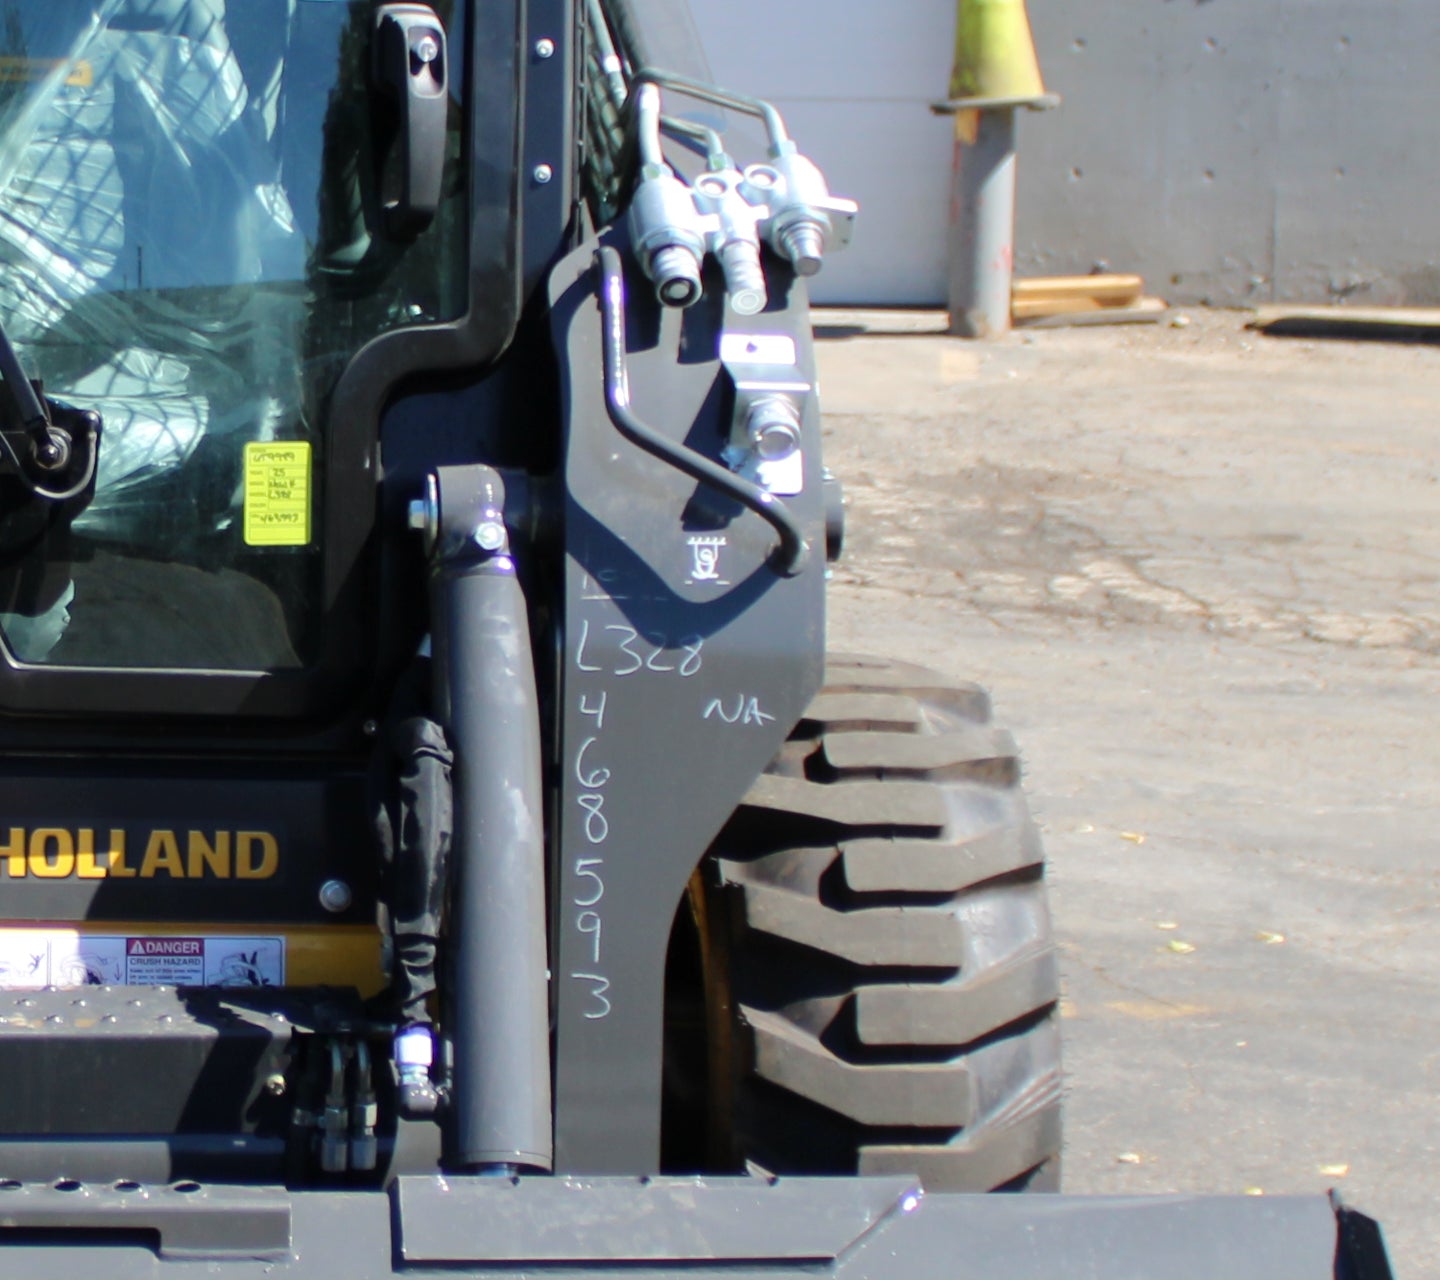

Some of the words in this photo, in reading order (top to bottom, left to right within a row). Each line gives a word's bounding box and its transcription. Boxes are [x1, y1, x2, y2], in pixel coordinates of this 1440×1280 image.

[576, 619, 703, 677] L328
[145, 941, 200, 954] DANGER
[129, 957, 161, 966] CRUSH
[163, 957, 201, 966] HAZARD
